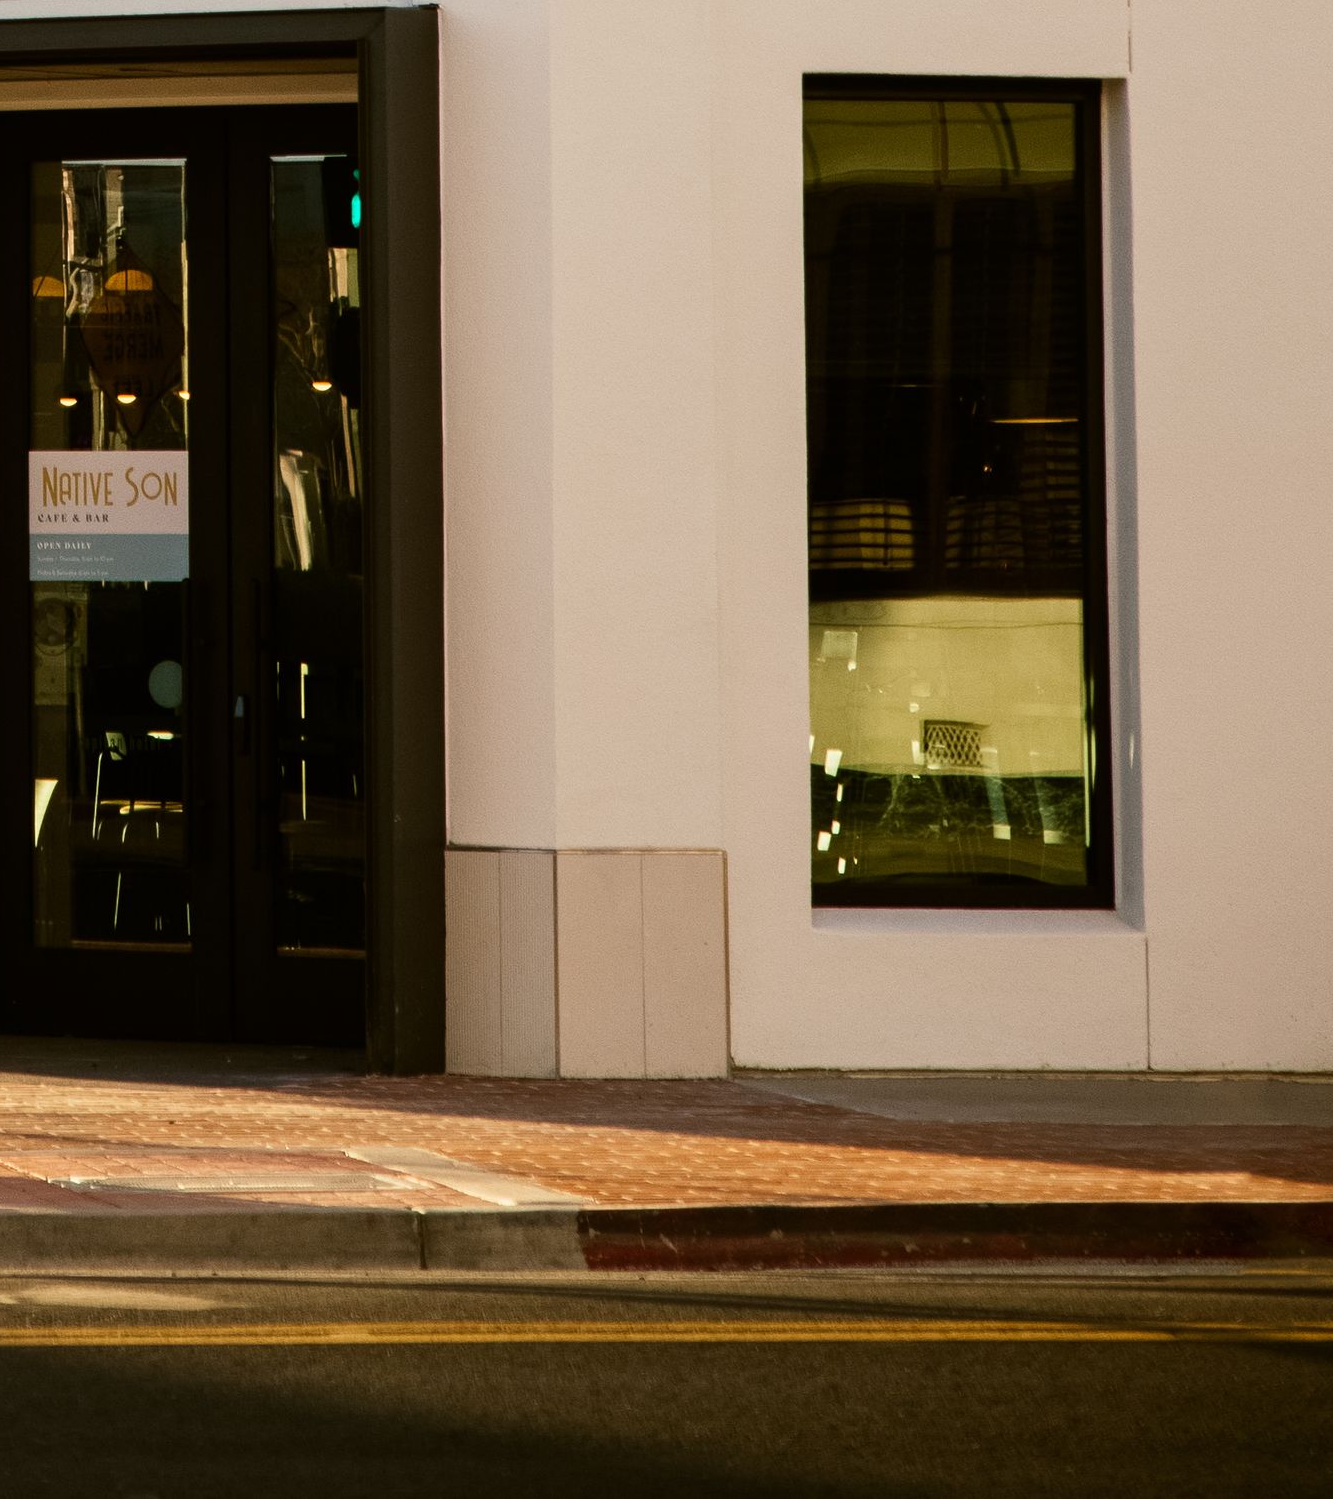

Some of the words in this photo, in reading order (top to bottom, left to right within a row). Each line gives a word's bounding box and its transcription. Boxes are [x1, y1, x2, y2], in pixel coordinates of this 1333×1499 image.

[37, 513, 68, 523] CAFE
[72, 513, 81, 523] &
[86, 513, 110, 523] BAR
[36, 541, 62, 550] OPEN
[64, 541, 93, 550] DAILY
